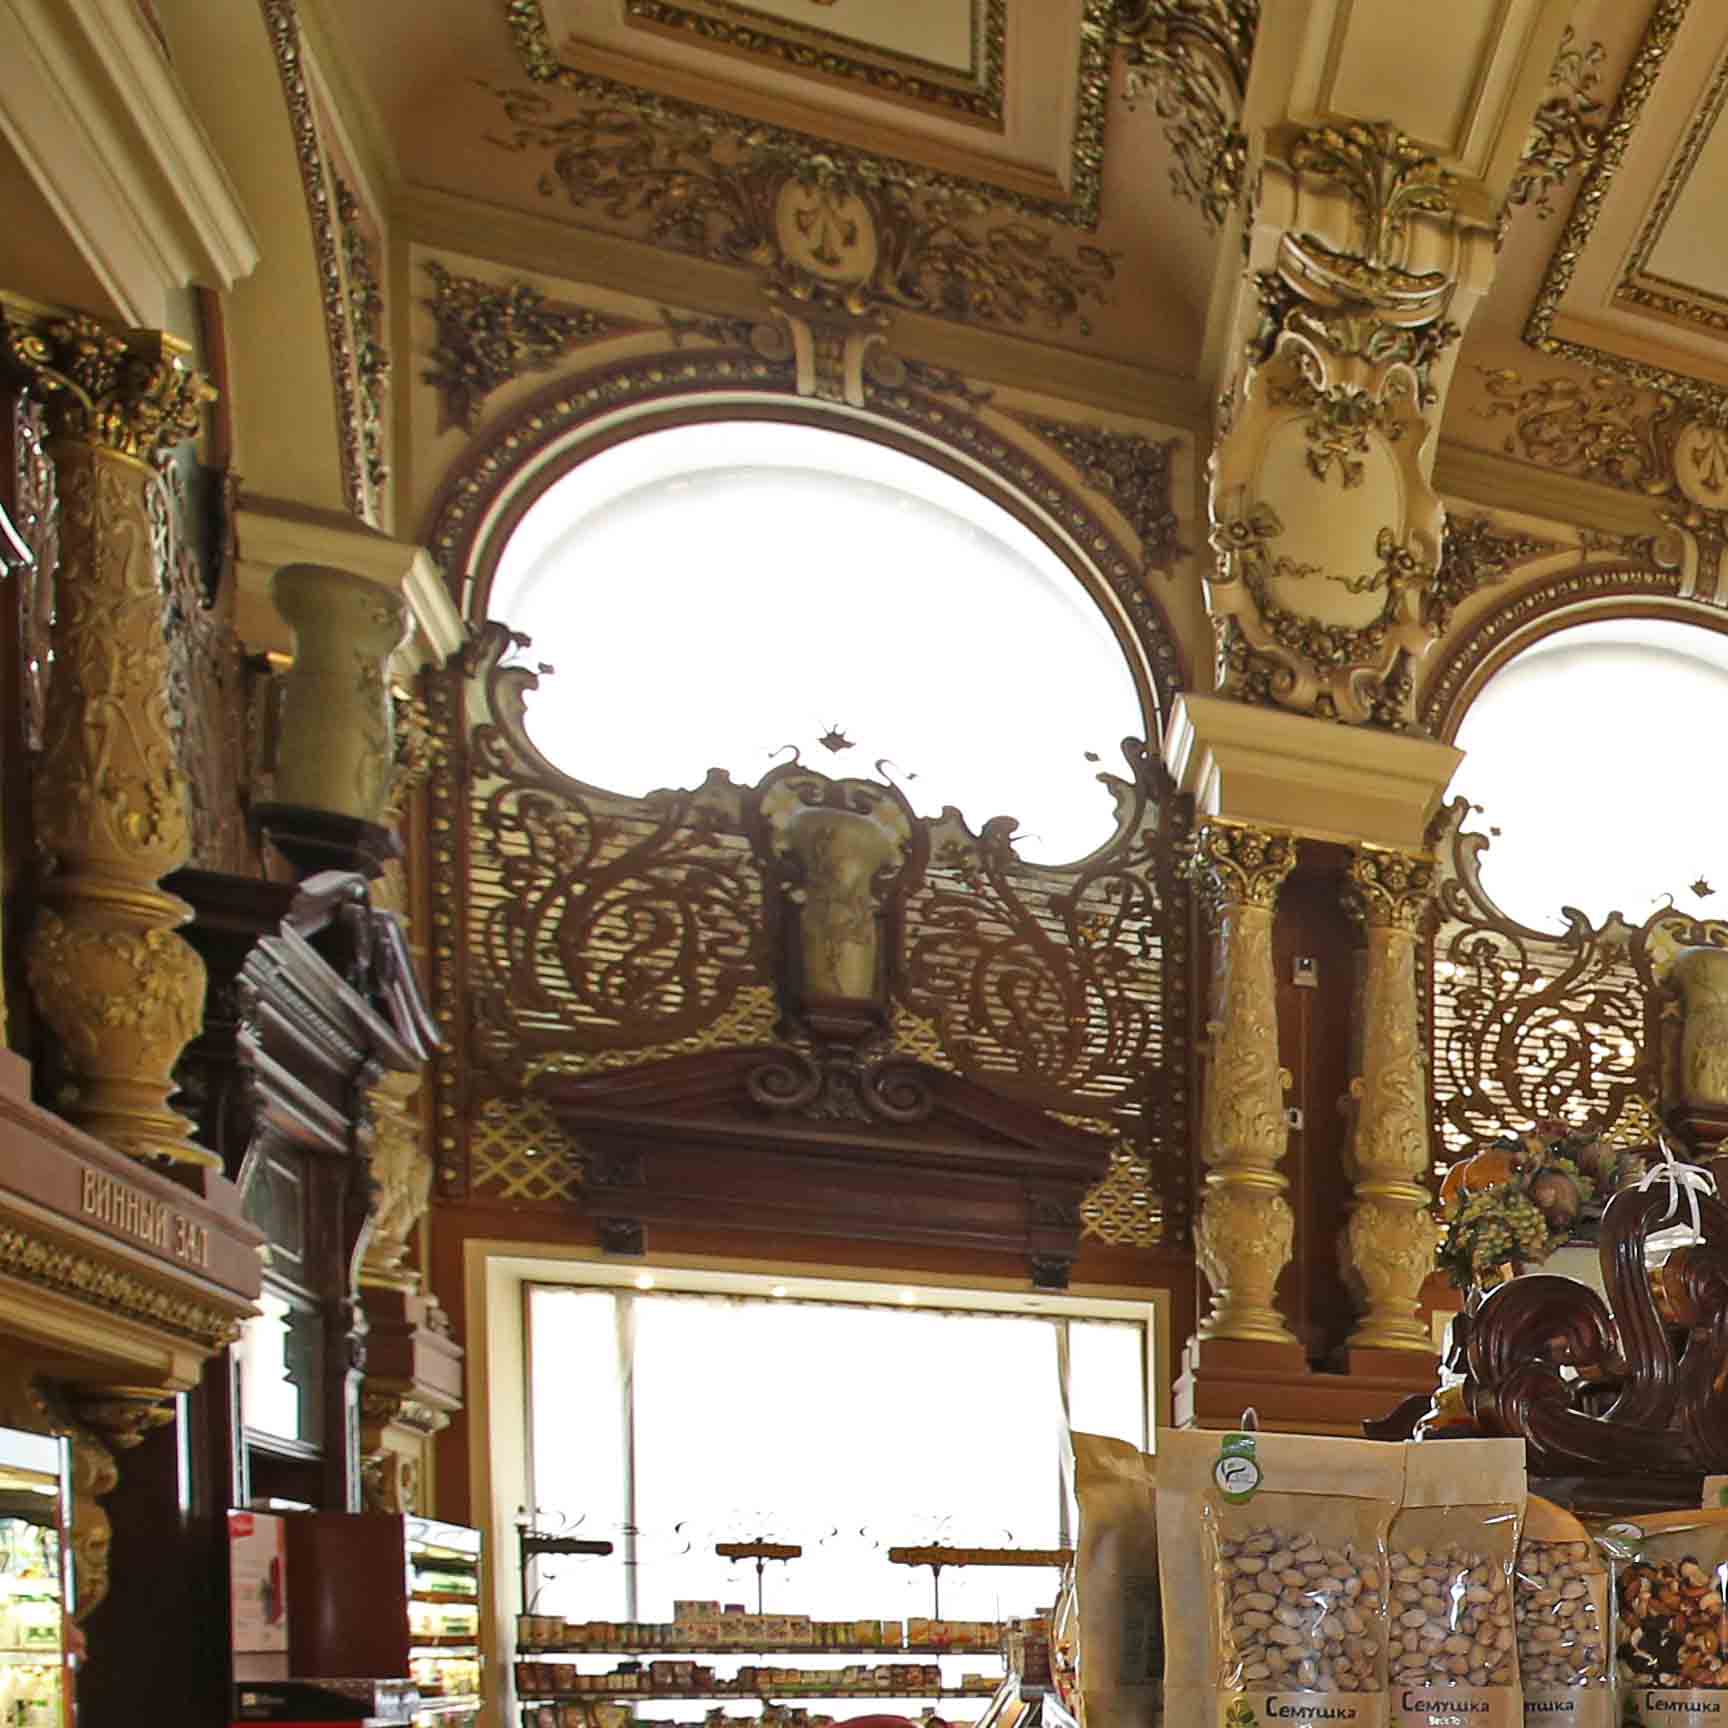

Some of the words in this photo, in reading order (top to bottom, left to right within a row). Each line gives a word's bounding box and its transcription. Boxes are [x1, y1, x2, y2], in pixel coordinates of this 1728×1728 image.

[82, 1168, 169, 1249] ВИННЫЙ
[175, 1215, 208, 1268] ЗАЛ
[1265, 1696, 1357, 1719] Семушка
[1402, 1691, 1490, 1713] Семушка
[1524, 1700, 1575, 1713] ушка
[1645, 1691, 1720, 1713] Семушка
